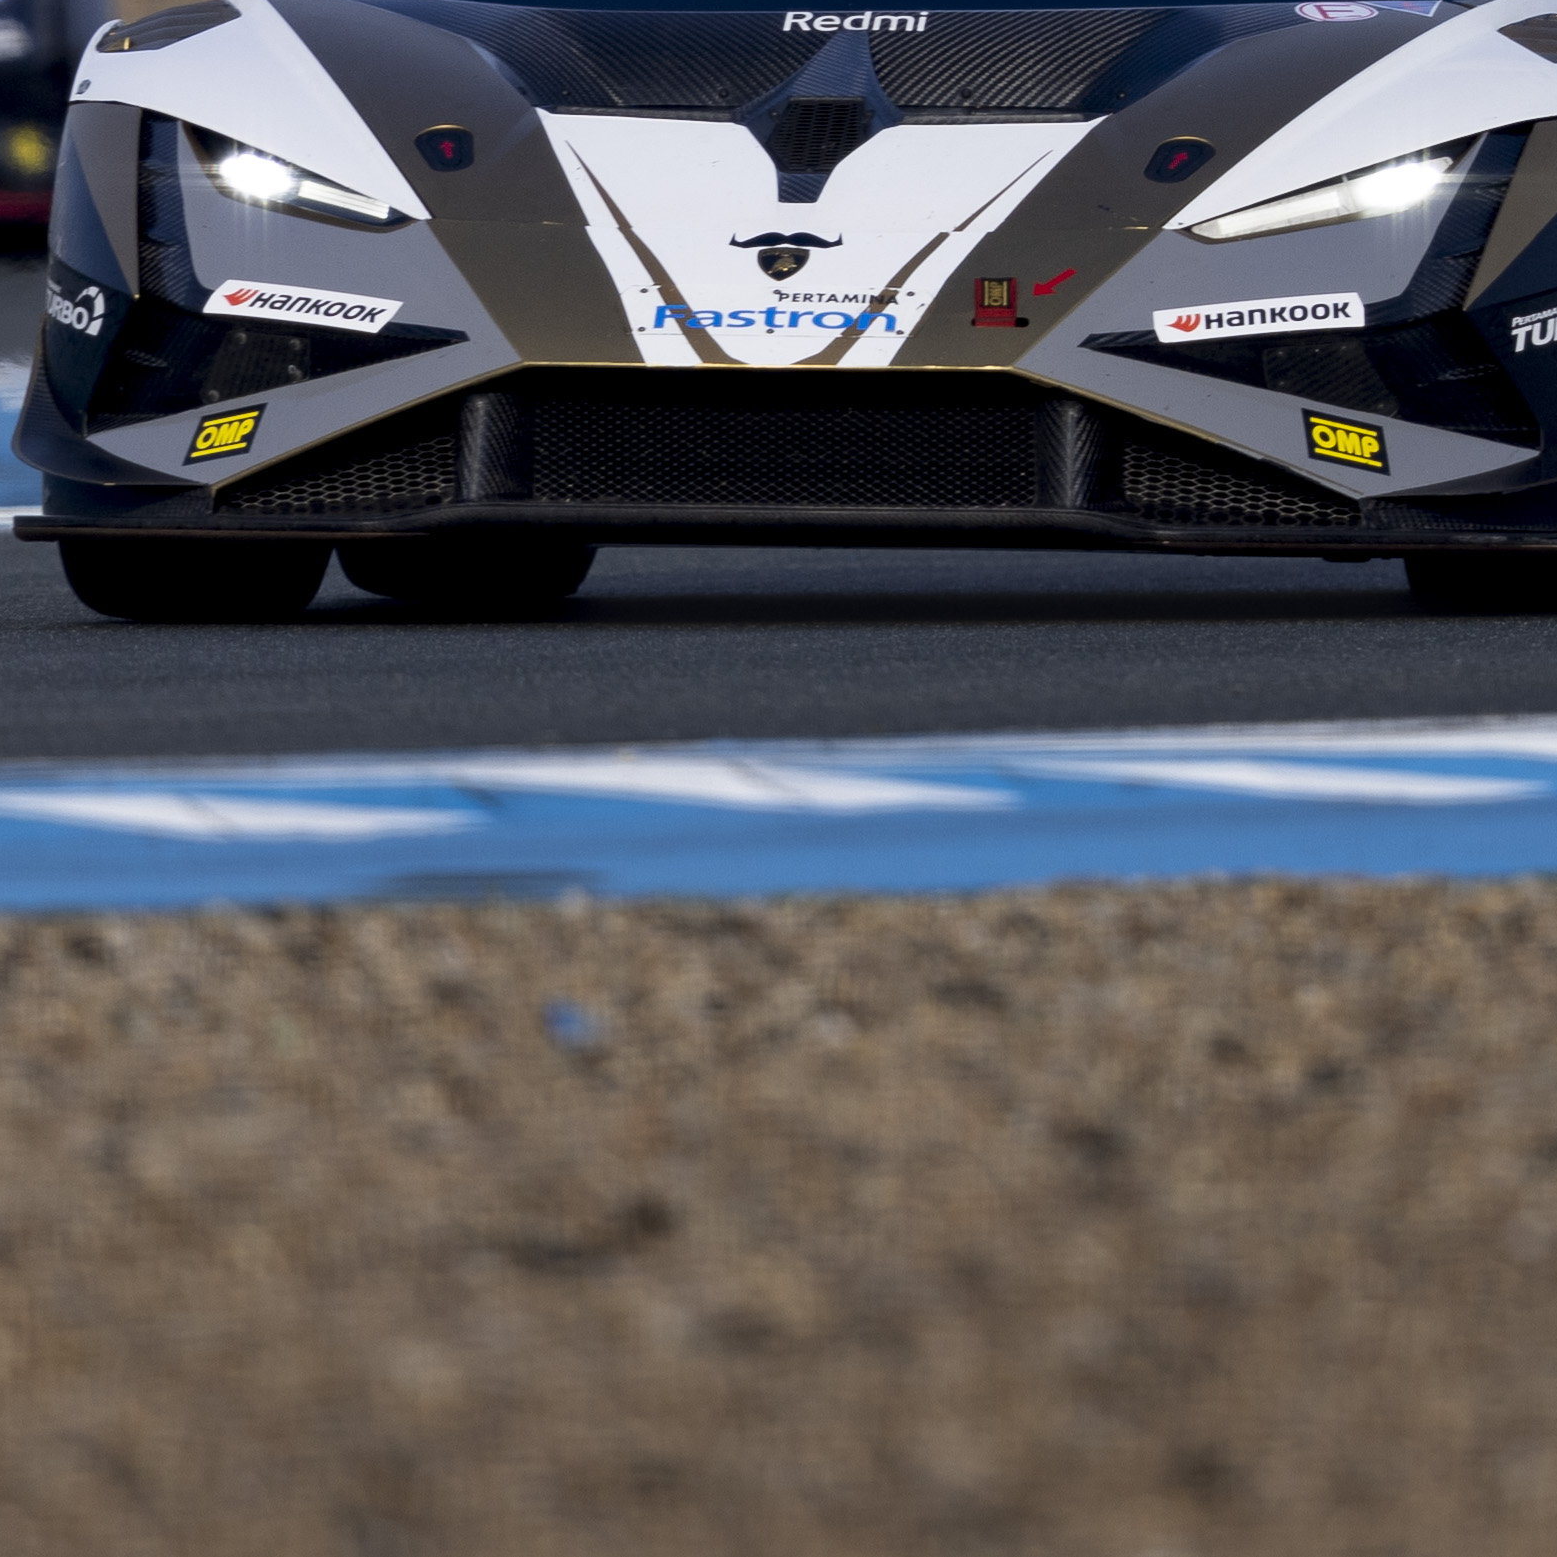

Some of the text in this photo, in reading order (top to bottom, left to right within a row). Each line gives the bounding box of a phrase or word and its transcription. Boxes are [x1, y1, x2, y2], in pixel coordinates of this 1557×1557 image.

[782, 10, 929, 32] Redmi
[778, 292, 899, 305] PERTAMINA
[653, 304, 898, 333] Fastron
[196, 418, 255, 450] OMP
[1312, 425, 1380, 458] OMP
